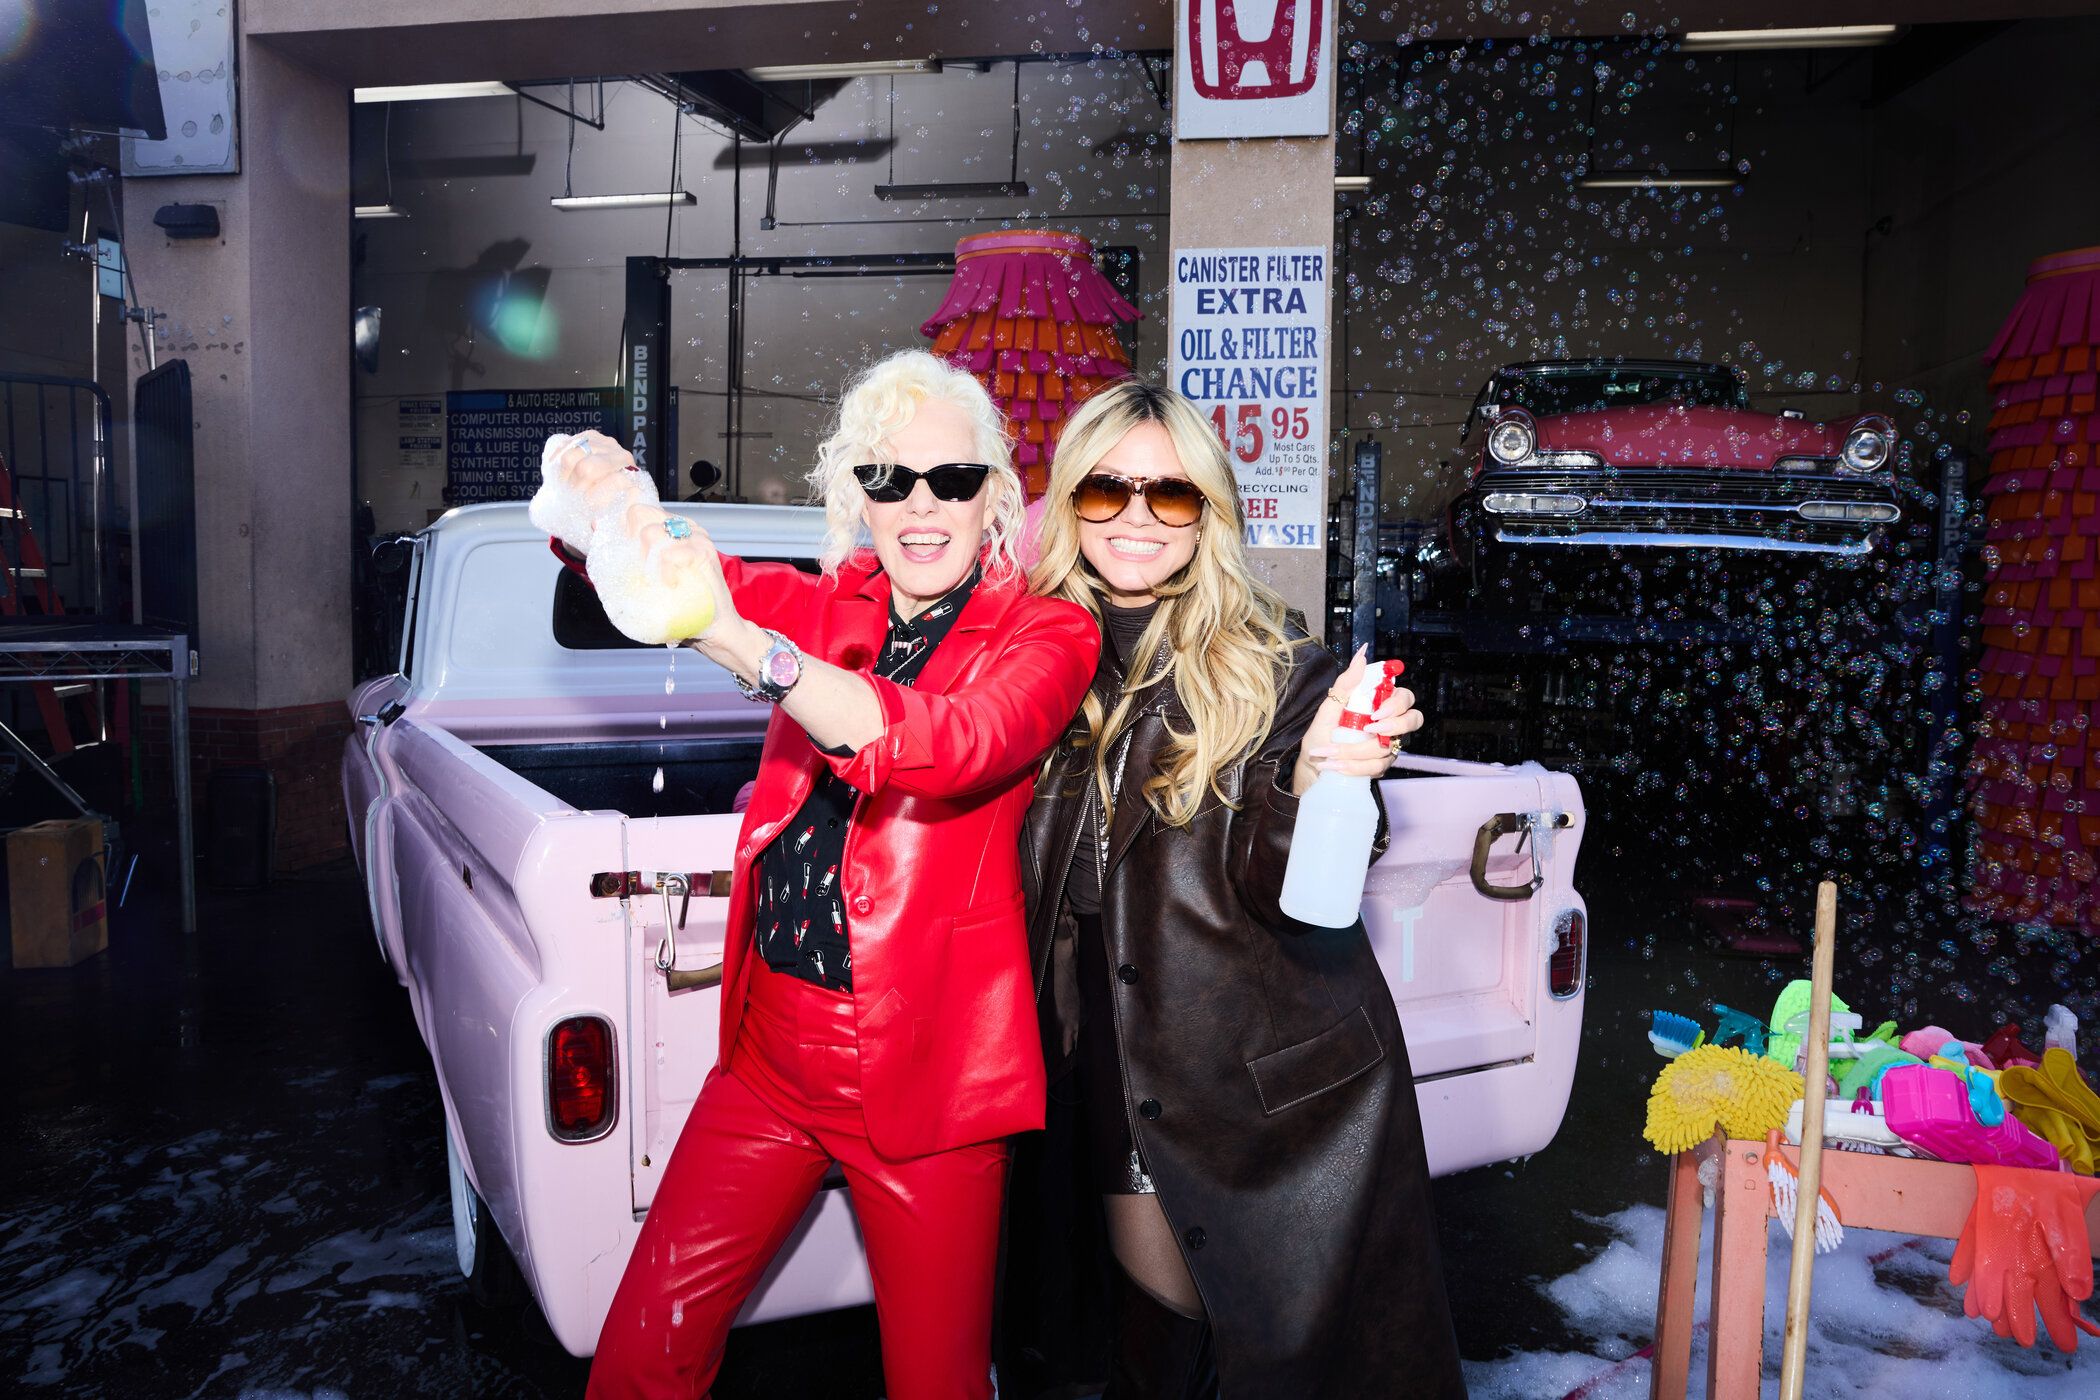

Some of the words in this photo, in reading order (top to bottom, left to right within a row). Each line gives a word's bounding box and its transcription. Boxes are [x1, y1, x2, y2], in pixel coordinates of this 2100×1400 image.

[1178, 256, 1260, 283] CANISTER
[1267, 255, 1323, 282] FILTER
[1197, 287, 1307, 315] EXTRA
[1181, 366, 1317, 400] CHANGE
[516, 394, 541, 407] AUTO
[543, 393, 575, 407] REPAIR
[576, 392, 600, 406] WITH
[633, 345, 648, 464] BENDPAK
[451, 413, 519, 425] COMPUTER
[523, 411, 602, 424] DIAGNOSTIC
[1271, 407, 1309, 440] 95
[451, 426, 543, 439] TRANSMISSION
[451, 442, 471, 453] OIL
[475, 442, 483, 453] &
[487, 441, 519, 453] LUBE
[523, 441, 539, 455] Up
[1273, 442, 1294, 451] Most
[1296, 442, 1315, 451] Cars
[451, 457, 519, 468] SYNTHETIC
[1270, 454, 1280, 464] Up
[1284, 454, 1293, 463] To
[1296, 454, 1301, 463] 5
[1303, 454, 1320, 463] Qts.
[451, 471, 493, 483] TIMING
[497, 471, 529, 482] BELT
[1292, 467, 1306, 476] Per
[452, 485, 507, 497] COOLING
